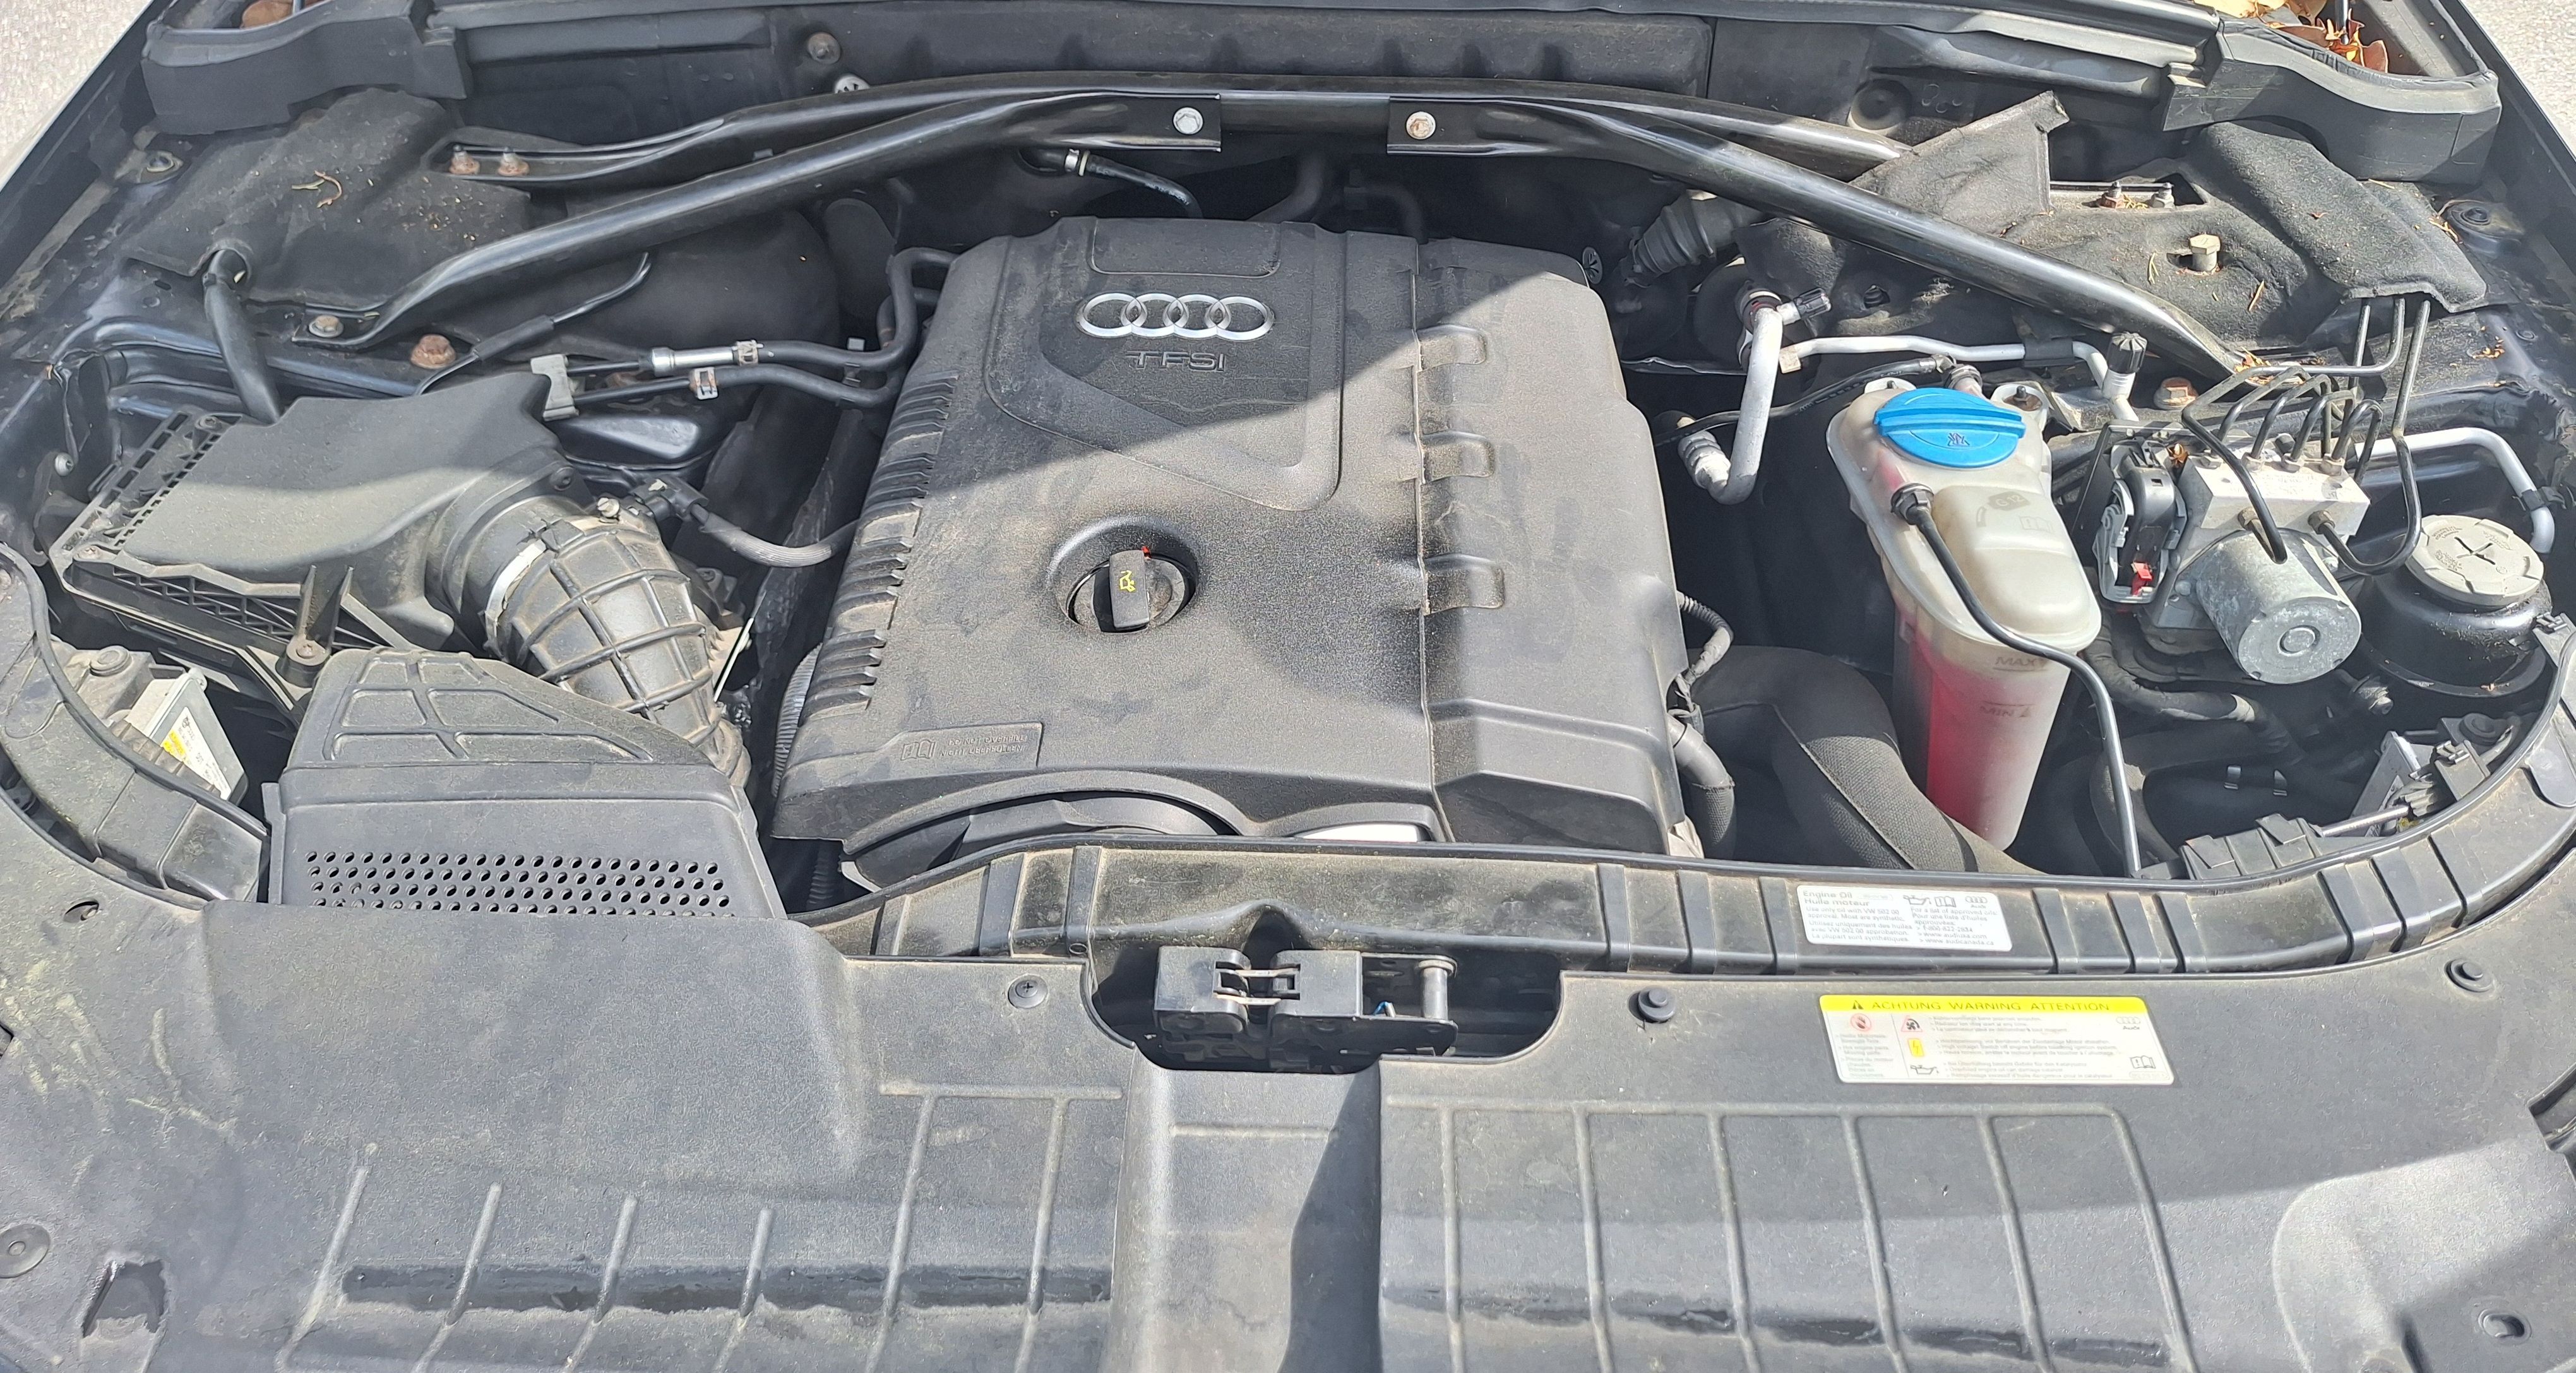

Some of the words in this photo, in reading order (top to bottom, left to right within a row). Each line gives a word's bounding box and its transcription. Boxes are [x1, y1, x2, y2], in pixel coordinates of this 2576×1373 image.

[1126, 350, 1226, 372] TFSI
[1995, 657, 2036, 667] MAX
[1981, 706, 2015, 717] MIN
[1803, 890, 1837, 899] Engine
[1872, 1002, 1941, 1011] ACHTUNG
[1951, 1002, 2021, 1011] WARNING
[2030, 1002, 2109, 1011] ATTENTION
